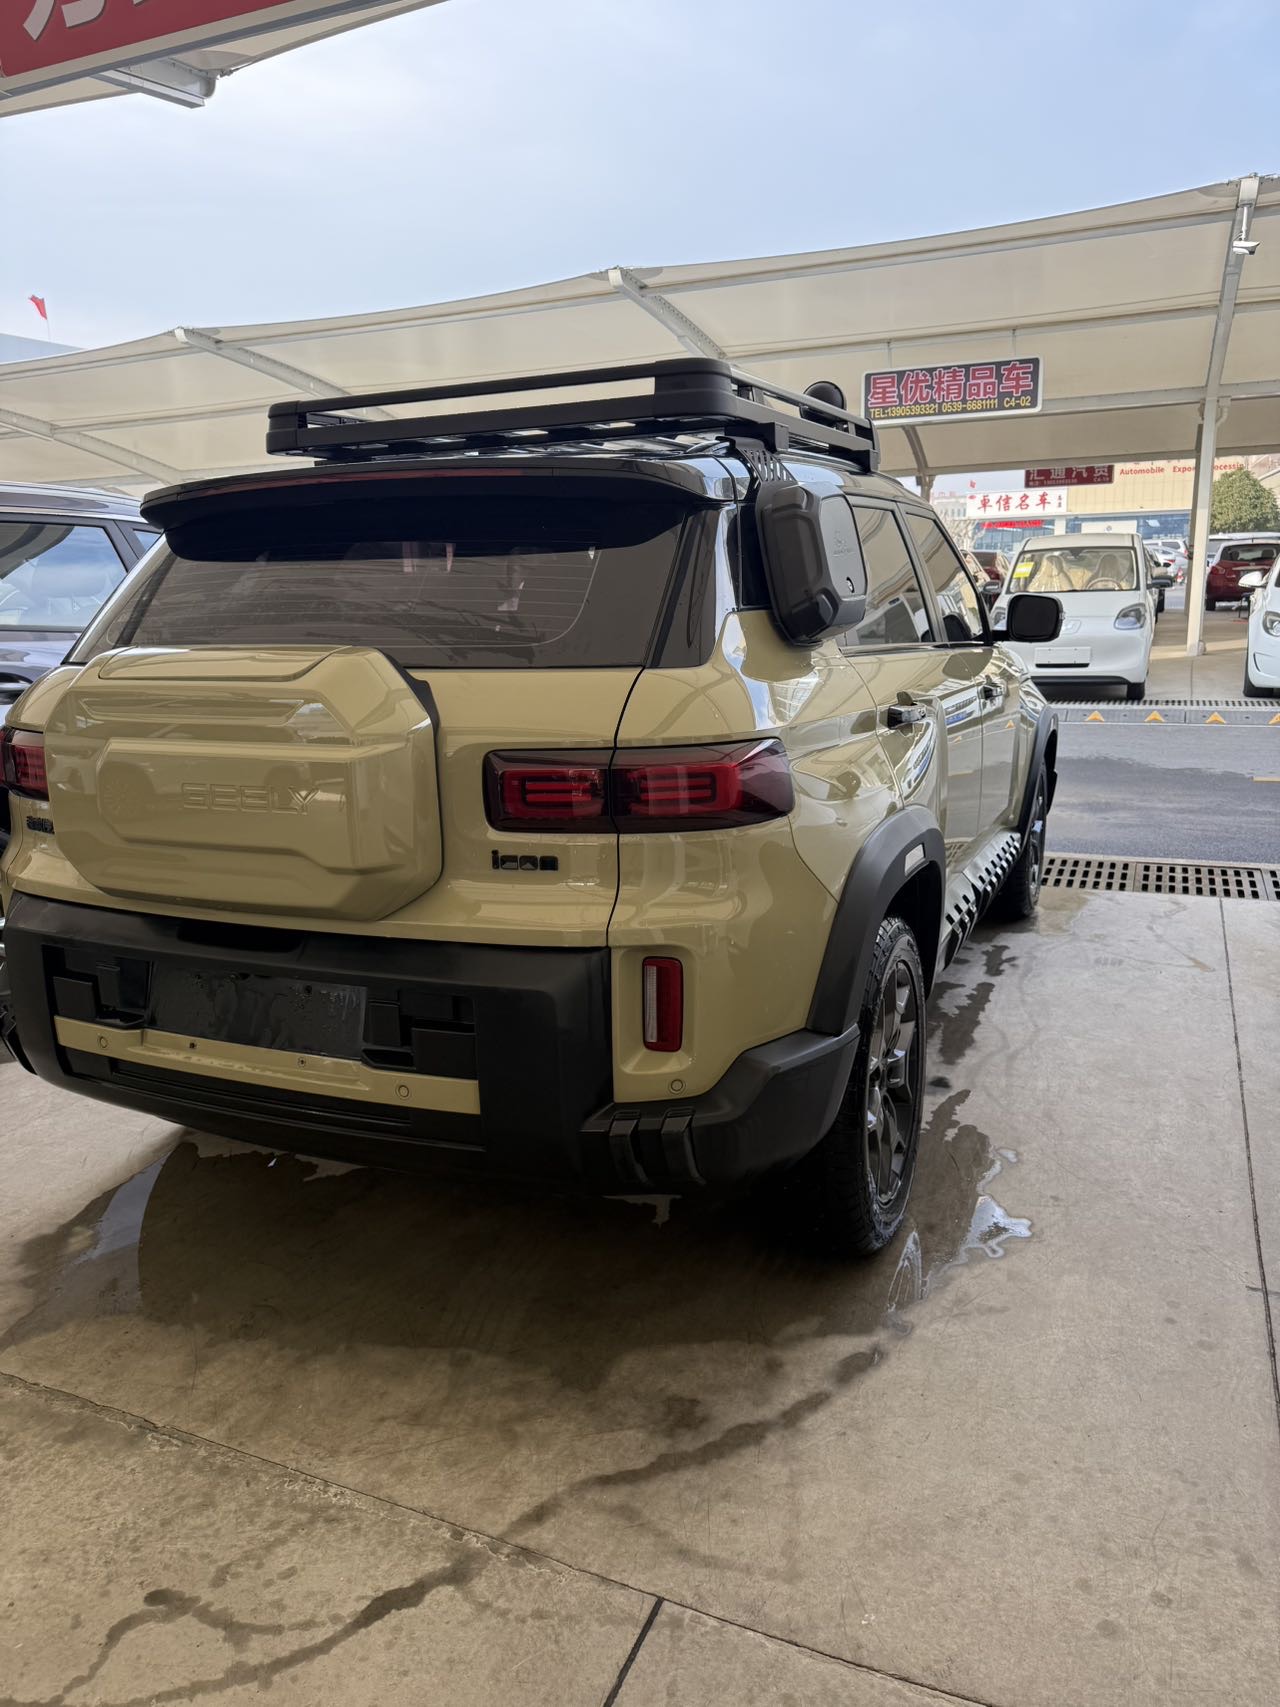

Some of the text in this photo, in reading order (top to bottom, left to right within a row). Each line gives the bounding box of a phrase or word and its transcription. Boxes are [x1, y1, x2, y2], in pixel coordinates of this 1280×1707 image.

[868, 361, 1033, 407] 星优精品车
[869, 396, 1031, 419] TEL:13905393321 0539-6681111 C4-02
[1120, 466, 1165, 475] Automobile
[181, 782, 320, 816] GEELY
[491, 849, 559, 872] icon
